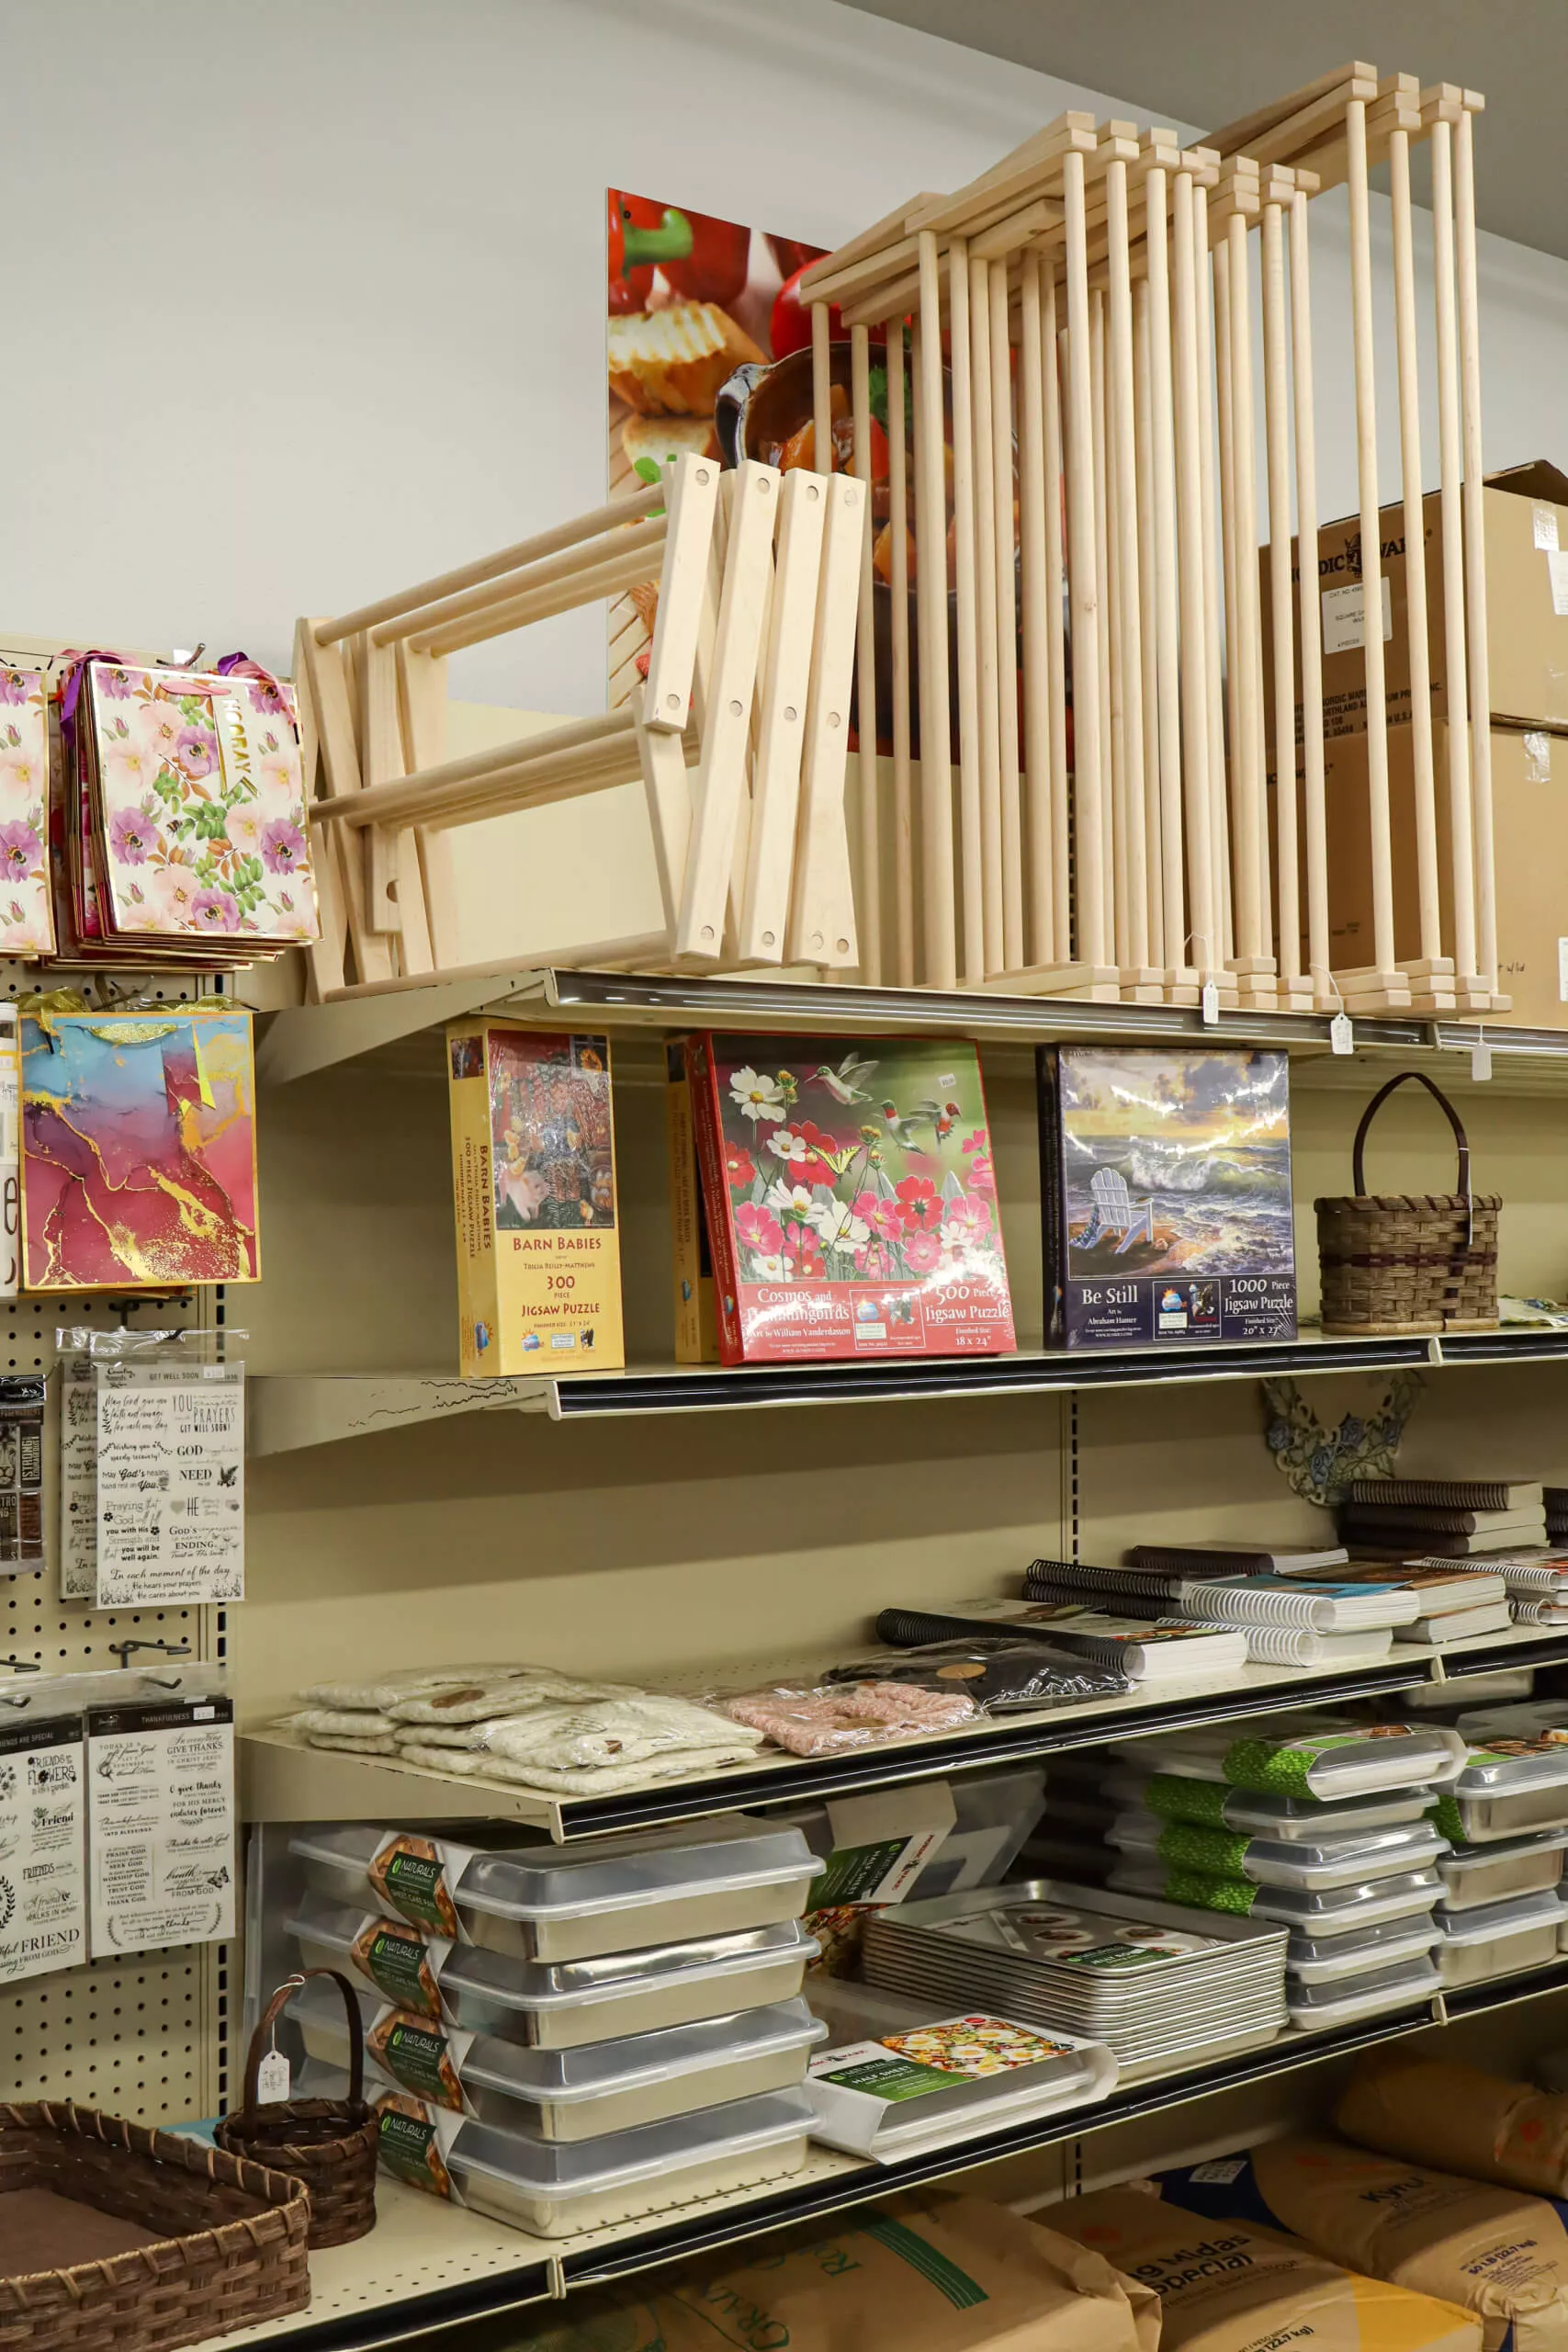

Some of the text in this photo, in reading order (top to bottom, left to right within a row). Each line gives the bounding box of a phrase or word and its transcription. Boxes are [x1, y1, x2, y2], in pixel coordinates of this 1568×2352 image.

[220, 699, 252, 774] HOORAY
[479, 1145, 491, 1250] BARN BABIES
[513, 1237, 602, 1251] BARN BABIES
[547, 1275, 575, 1290] 300
[1229, 1279, 1291, 1294] 1000 Piece
[757, 1288, 831, 1304] Cosmos and
[935, 1286, 970, 1306] 500
[1081, 1284, 1138, 1305] Be Still
[521, 1303, 601, 1317] JIGSAW PUZZLE
[1224, 1294, 1293, 1315] Jigsaw Puzzle
[925, 1303, 1010, 1324] Jigsaw Puzzle
[773, 1329, 802, 1338] William
[172, 1395, 192, 1412] YOU
[193, 1407, 236, 1423] PRAYERS
[180, 1424, 191, 1433] GET
[194, 1424, 209, 1433] WELL
[176, 1445, 203, 1456] GOD
[22, 1438, 33, 1479] STRONG
[118, 1468, 145, 1481] God's
[178, 1469, 213, 1481] NEED
[106, 1500, 143, 1512] Praying
[186, 1497, 199, 1517] HE
[120, 1554, 136, 1562] well
[110, 1568, 124, 1581] In
[150, 1568, 186, 1578] moment
[198, 1565, 210, 1576] the
[141, 1713, 190, 1724] THANKFULNESS
[19, 1731, 54, 1744] ARE SPECIAL
[166, 1744, 186, 1755] GIVE
[177, 1780, 222, 1795] give thanks
[41, 1811, 73, 1826] Friend
[23, 1862, 55, 1881] FRIENDS
[402, 1860, 436, 1879] NATURALS
[107, 1886, 129, 1894] TRUST
[171, 1886, 215, 1897] FROM GOD
[21, 1928, 80, 1953] FRIEND
[19, 1949, 60, 1964] FROM GOD
[384, 1939, 420, 1960] NATURALS
[402, 2031, 439, 2052] NATURALS
[390, 2118, 427, 2140] NATURALS
[1156, 2234, 1251, 2266] Midas
[1145, 2253, 1256, 2296] Special
[1468, 2265, 1483, 2275] 50
